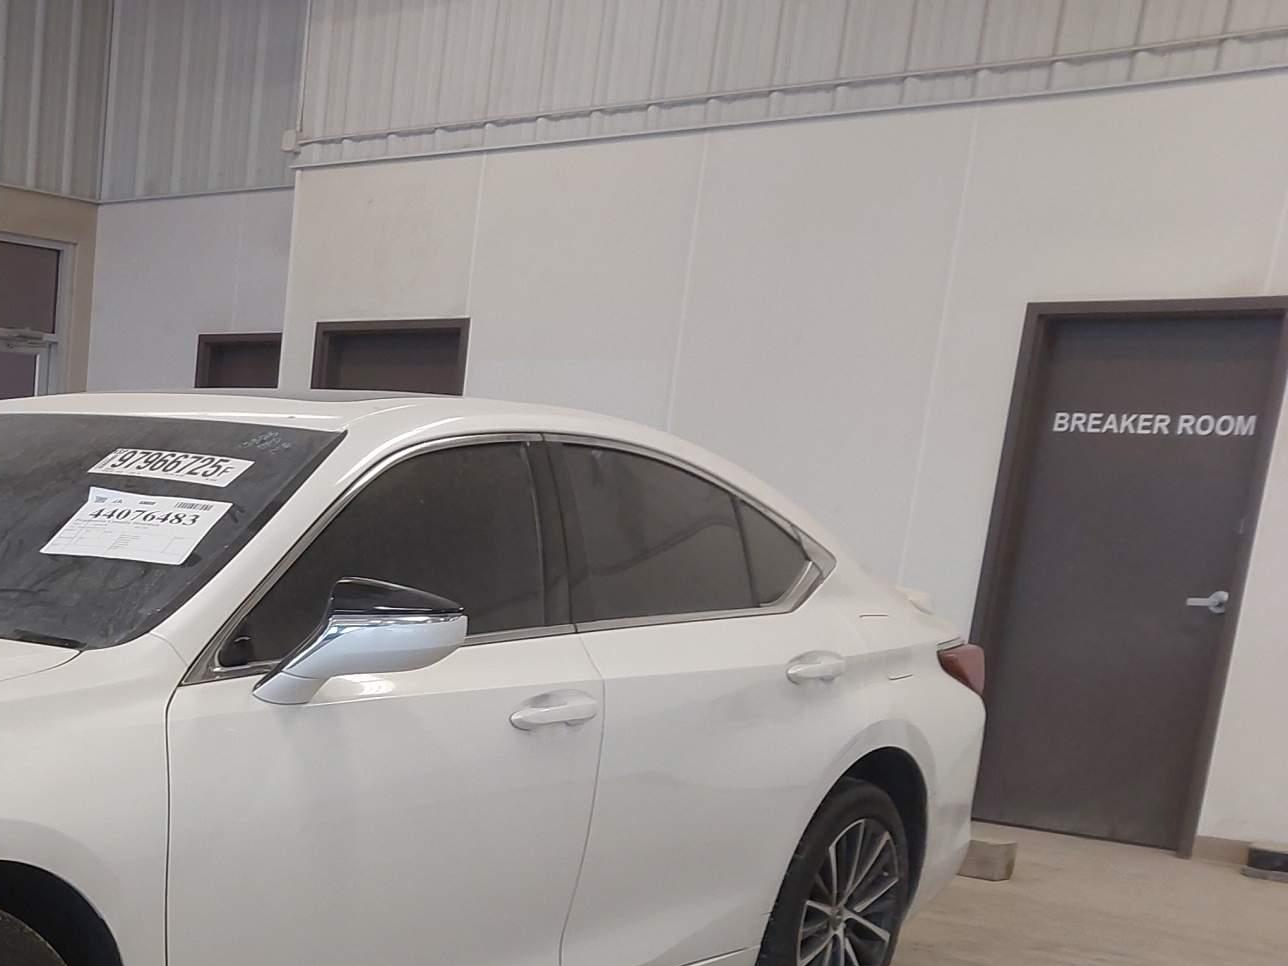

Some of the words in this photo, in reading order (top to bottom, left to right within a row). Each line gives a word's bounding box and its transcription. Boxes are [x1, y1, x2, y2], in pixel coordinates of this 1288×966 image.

[1052, 412, 1171, 435] BREAKER
[1176, 414, 1258, 436] ROOM
[89, 507, 201, 526] 44076483
